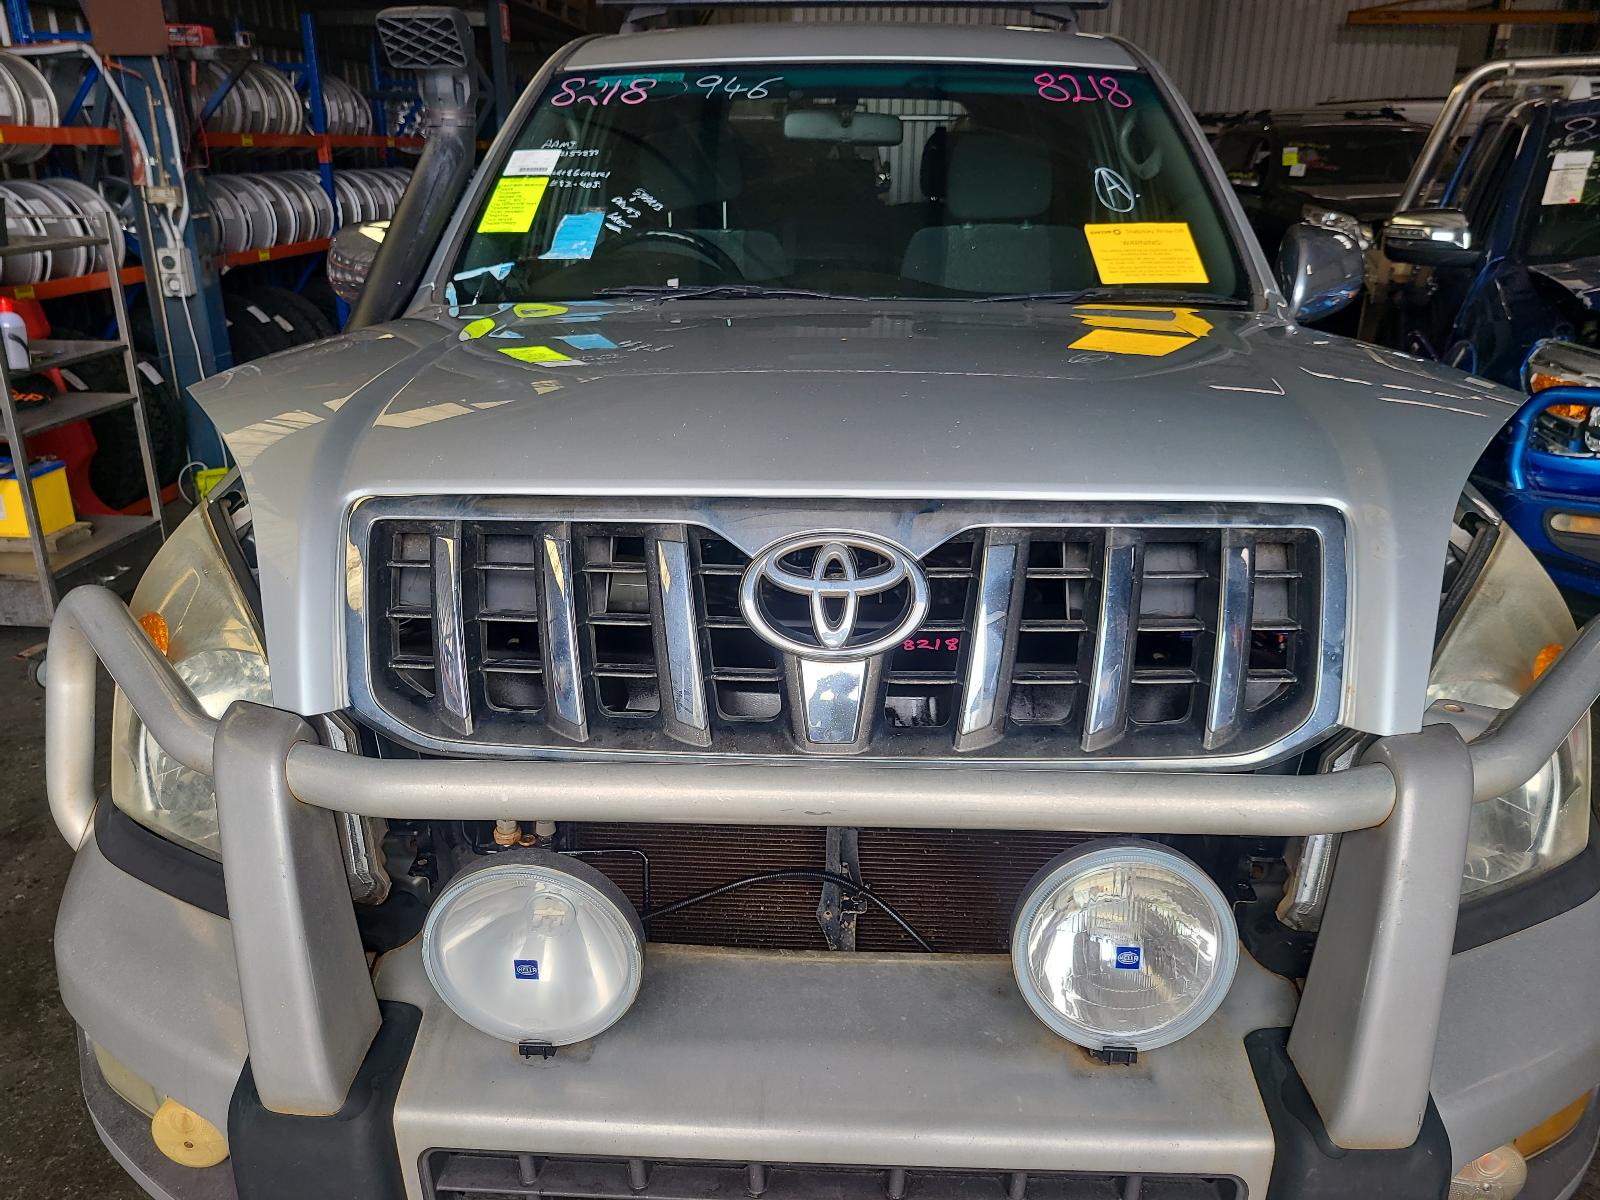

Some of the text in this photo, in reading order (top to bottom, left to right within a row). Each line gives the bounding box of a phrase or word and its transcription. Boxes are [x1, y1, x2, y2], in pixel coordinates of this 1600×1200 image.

[696, 75, 784, 100] 946
[1034, 72, 1133, 108] 8218
[903, 638, 960, 651] 8218
